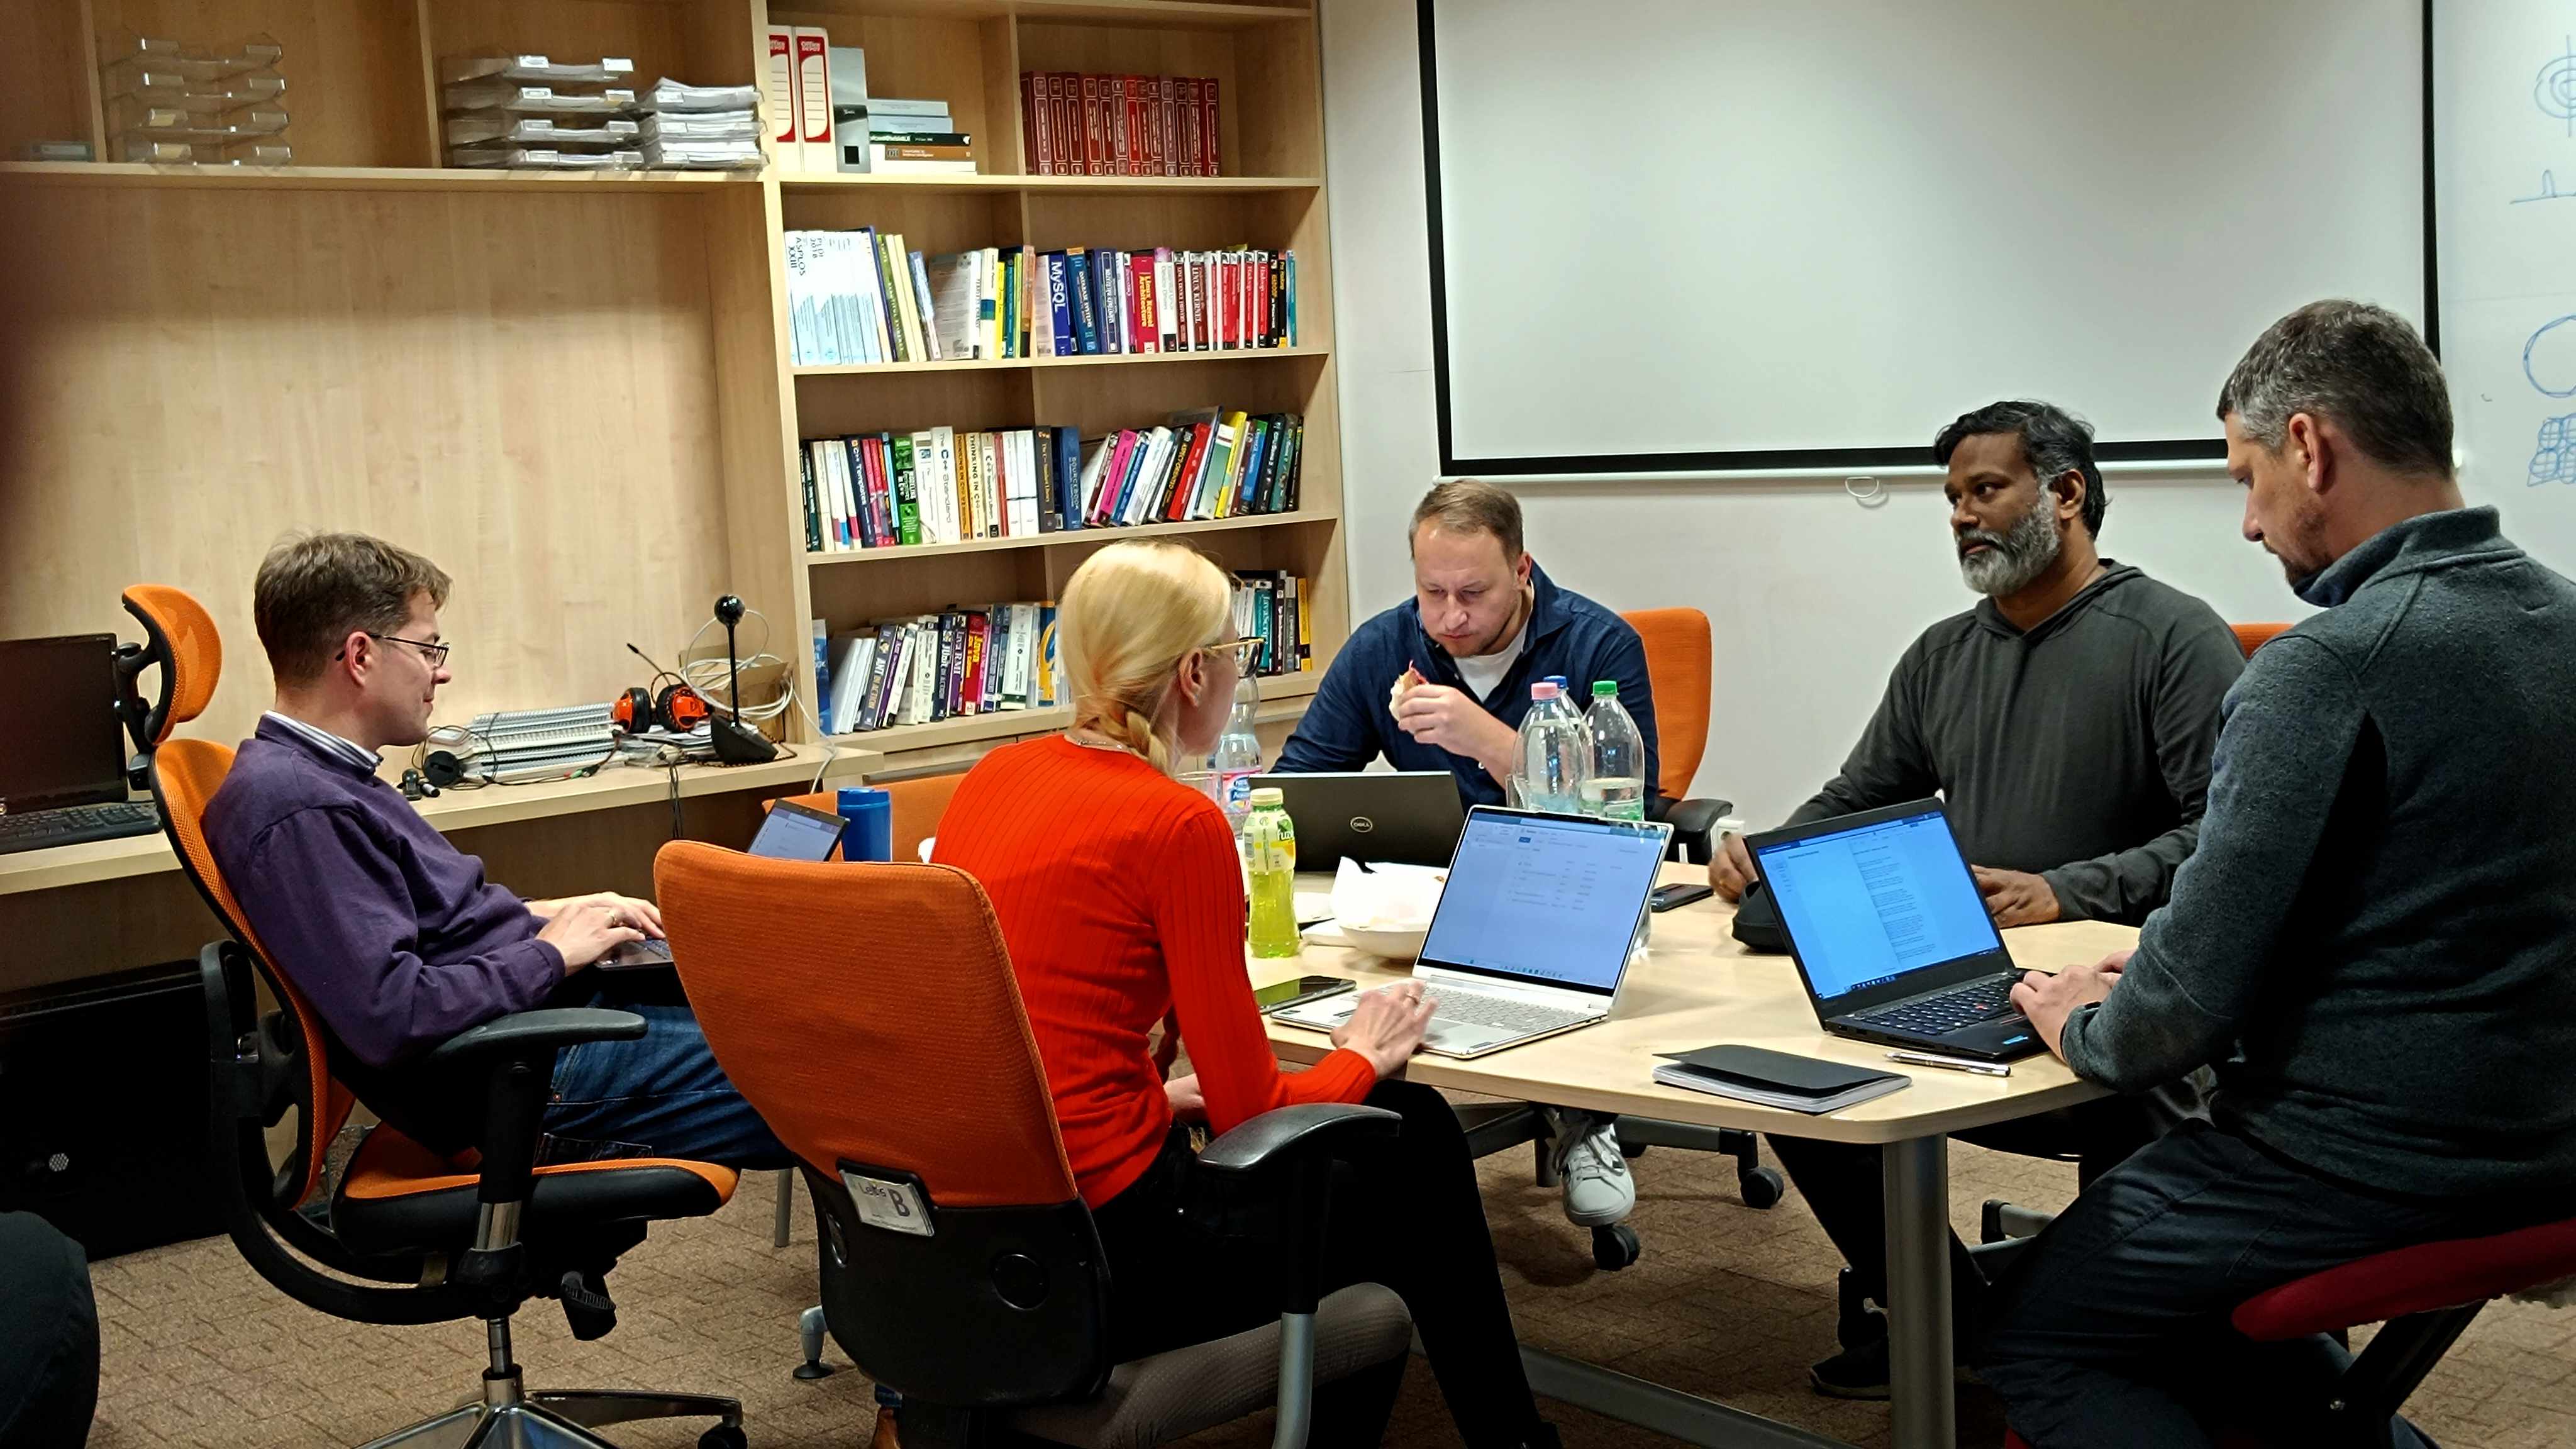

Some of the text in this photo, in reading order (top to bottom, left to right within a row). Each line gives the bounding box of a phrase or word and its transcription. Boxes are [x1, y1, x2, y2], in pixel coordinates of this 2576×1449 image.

[796, 237, 806, 275] ASPLOS
[1050, 262, 1065, 313] MySQL
[1138, 275, 1147, 327] Architecture
[1146, 299, 1154, 327] Kernel
[1193, 292, 1201, 324] KERNEL
[970, 435, 978, 479] THINKING
[974, 482, 979, 491] IN
[856, 464, 867, 506] Templates
[943, 474, 952, 523] Standard
[1071, 457, 1080, 510] SOURCEBOOK
[875, 657, 887, 676] ANT
[940, 643, 952, 668] JUnit
[953, 631, 965, 675] Java RMI
[972, 635, 983, 663] Java
[868, 682, 880, 709] ACTION
[887, 1188, 911, 1217] B
